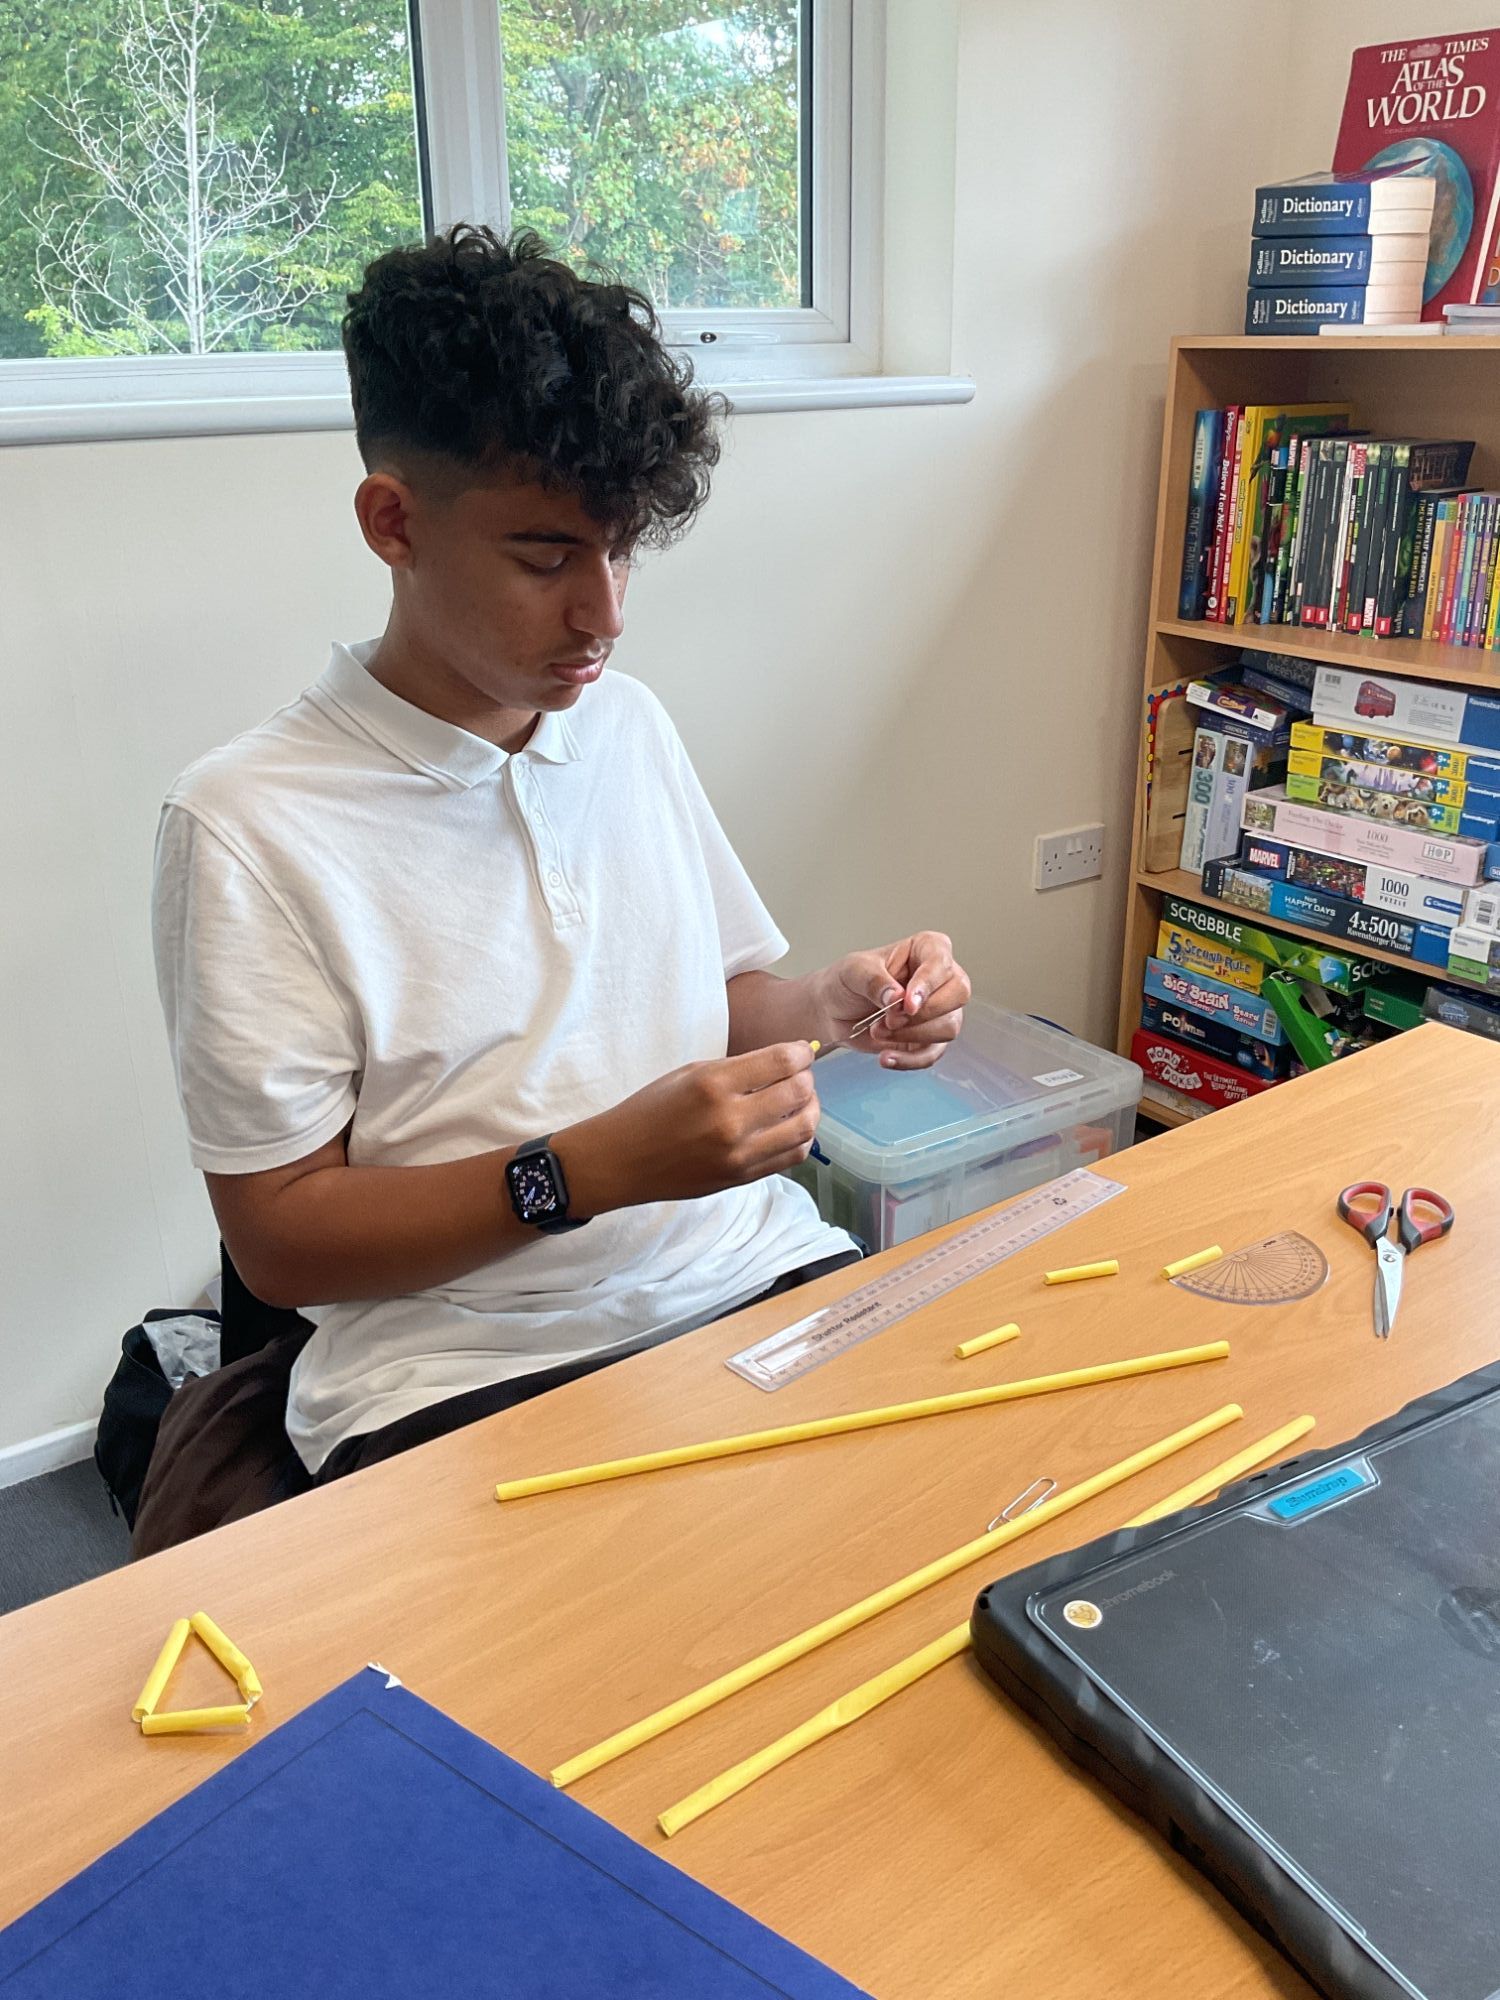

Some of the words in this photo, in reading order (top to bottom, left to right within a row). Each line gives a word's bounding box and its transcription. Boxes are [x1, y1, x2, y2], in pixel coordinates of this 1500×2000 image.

[1381, 49, 1408, 64] THE
[1445, 37, 1489, 55] TIMES
[1391, 55, 1465, 94] ATLAS
[1367, 86, 1486, 128] WORLD
[1282, 196, 1354, 217] Dictionary
[1280, 248, 1354, 269] Dictionary
[1274, 298, 1348, 319] Dictionary
[1220, 459, 1230, 491] Believe
[1285, 472, 1293, 500] HULK
[1218, 502, 1224, 511] or
[1189, 506, 1200, 538] SPACE
[1216, 512, 1225, 533] Not!
[1364, 598, 1375, 627] MARVEL
[1194, 770, 1213, 804] 300
[1250, 848, 1280, 868] MARVEL
[1380, 878, 1409, 897] 1000
[1284, 896, 1312, 910] HAPPY
[1314, 904, 1336, 917] DAYS
[1379, 895, 1407, 908] PUZZLE
[1170, 903, 1242, 942] SCRABBLE
[1349, 911, 1399, 940] 4x500
[1168, 931, 1182, 955] 5
[1347, 927, 1389, 946] Ravensburger
[1390, 940, 1411, 952] Puzzle
[1148, 1048, 1180, 1068] WORD
[1163, 1067, 1201, 1088] POKER
